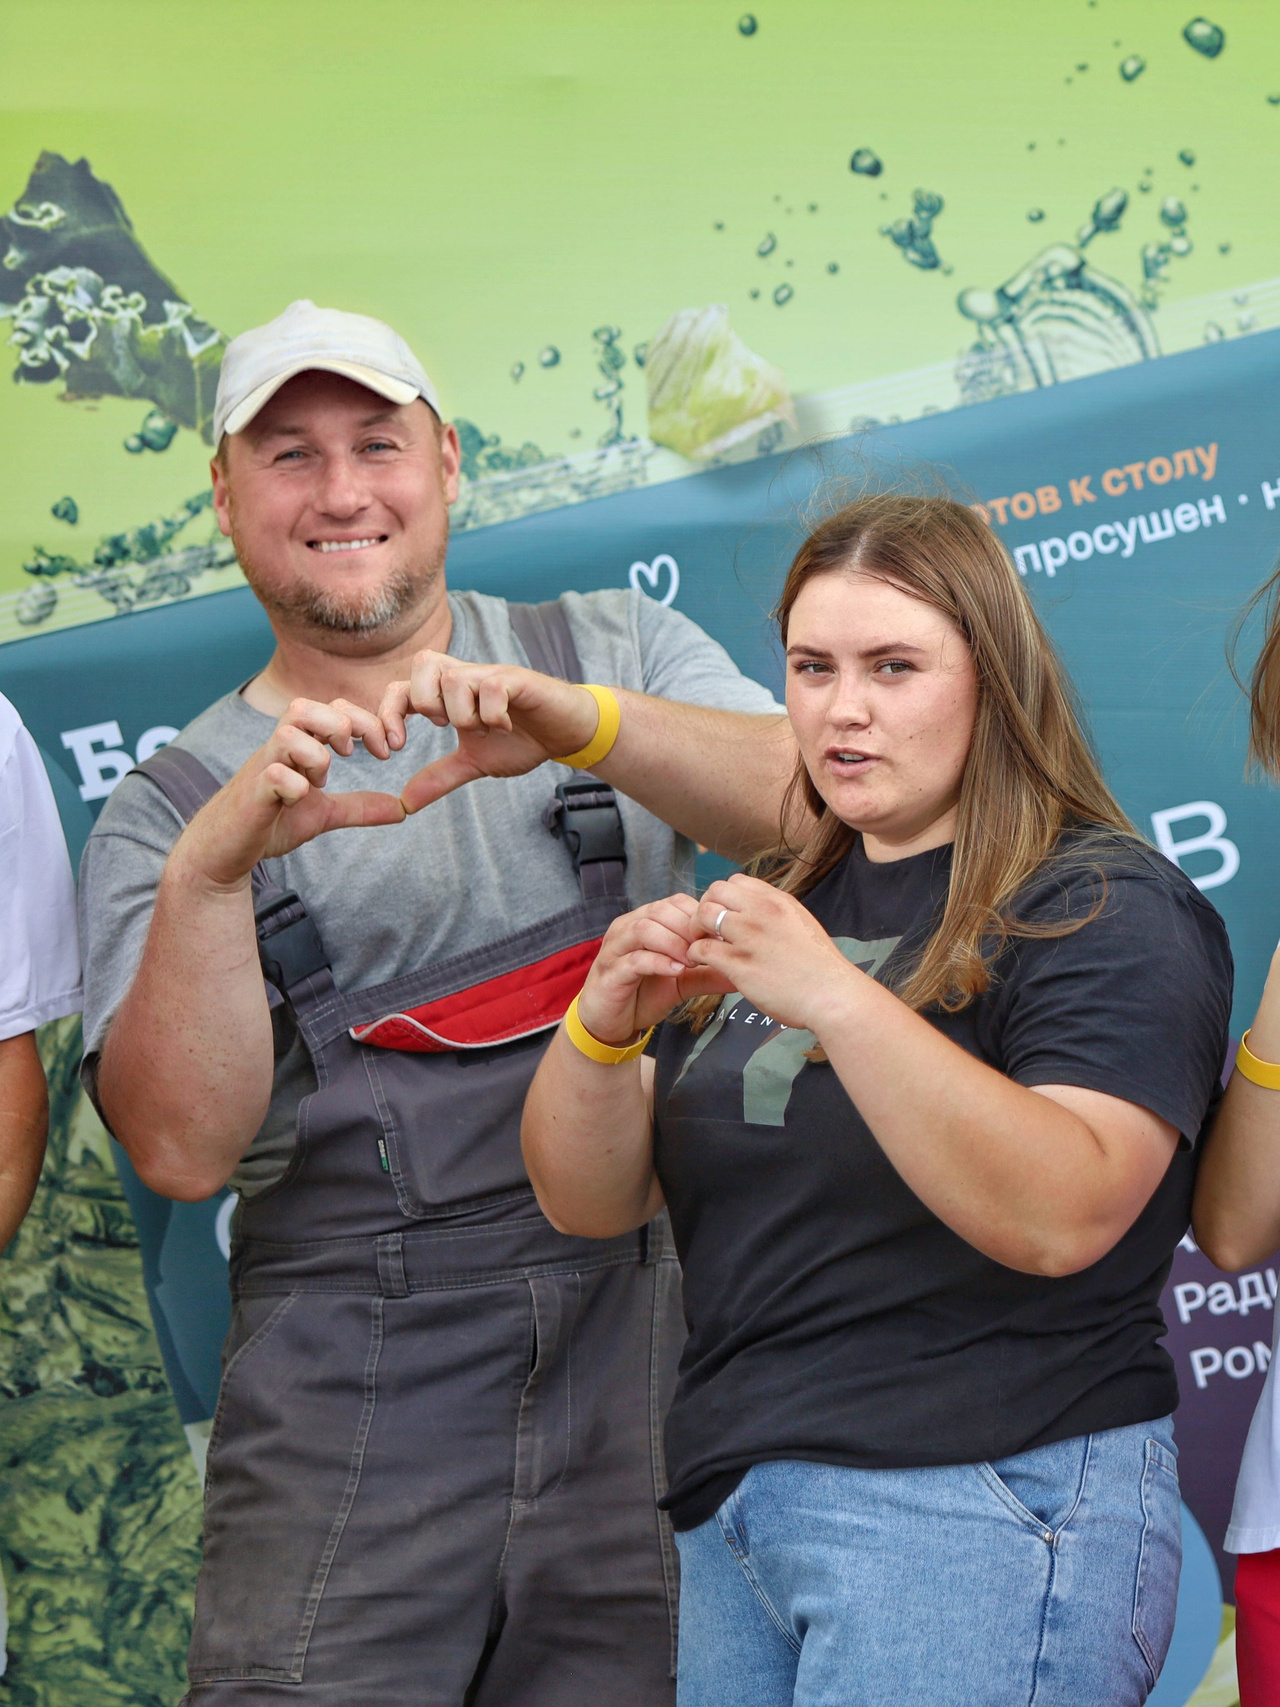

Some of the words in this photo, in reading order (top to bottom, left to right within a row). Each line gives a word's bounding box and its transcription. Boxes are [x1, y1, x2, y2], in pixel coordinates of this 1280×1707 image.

[1069, 475, 1097, 506] к
[1101, 442, 1219, 497] столу
[1013, 493, 1227, 577] просушен
